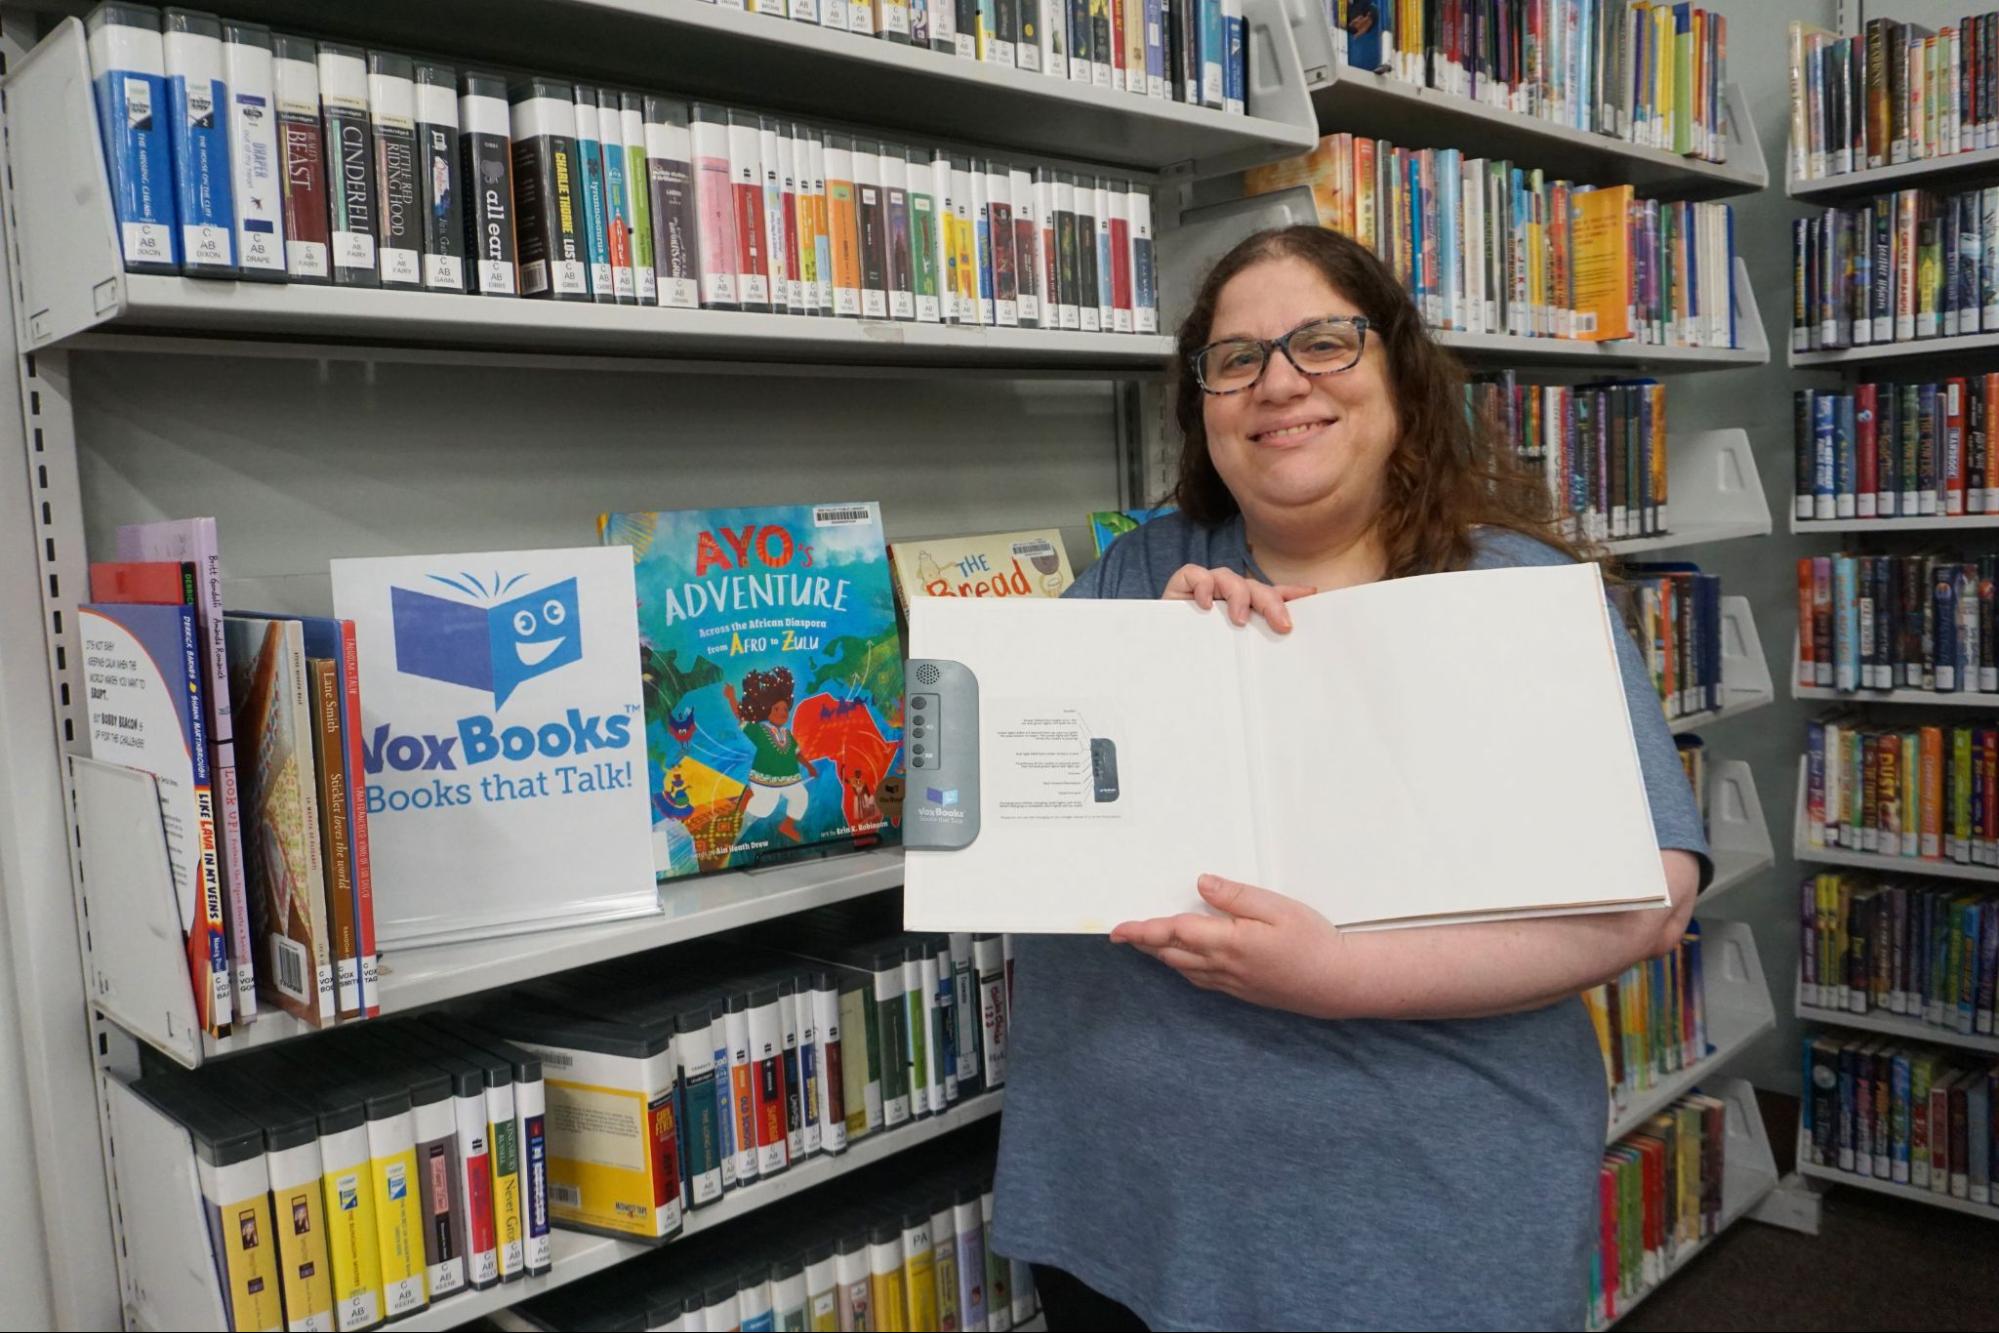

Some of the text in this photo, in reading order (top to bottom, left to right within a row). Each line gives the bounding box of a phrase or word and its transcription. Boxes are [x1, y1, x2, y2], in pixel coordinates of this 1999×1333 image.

[253, 142, 269, 179] DRAPER
[287, 129, 312, 191] BEAST
[387, 142, 402, 189] RIDING
[400, 144, 413, 204] LITTLE RED
[391, 194, 405, 236] HOOD
[555, 152, 577, 262] CHARLIE THORNE LOST
[590, 181, 604, 253] tyrannosaurus
[486, 190, 505, 262] all ear
[208, 555, 219, 577] Britt
[926, 557, 1032, 597] Bread
[956, 554, 990, 578] THE
[665, 573, 851, 626] ADVENTURE
[183, 616, 193, 648] DERRICK
[212, 618, 223, 645] Amanda
[699, 617, 827, 638] Across the African Diaspora
[707, 630, 819, 656] from AFRO to ZULU
[186, 650, 195, 680] BARNES
[190, 695, 199, 720] SHAWN
[323, 671, 339, 734] Lane Smith
[364, 762, 632, 813] Books that Talk!
[1879, 752, 1896, 798] DUST
[224, 770, 238, 834] LOOK UP!
[330, 773, 350, 890] Stickler loves the world
[750, 840, 769, 849] Drew
[198, 793, 219, 919] LIKE LAVA IN MY VEINS
[319, 977, 334, 985] VOX
[363, 969, 378, 977] VOX
[364, 976, 378, 984] TAG
[505, 1179, 516, 1212] Never
[913, 1231, 929, 1246] PA
[441, 1263, 448, 1272] C
[481, 1262, 494, 1272] AB
[509, 1251, 521, 1260] AB
[400, 1281, 407, 1290] C
[439, 1273, 452, 1283] AB
[353, 1297, 360, 1306] C
[398, 1291, 412, 1300] AB
[305, 1317, 314, 1326] C
[351, 1307, 365, 1318] AB
